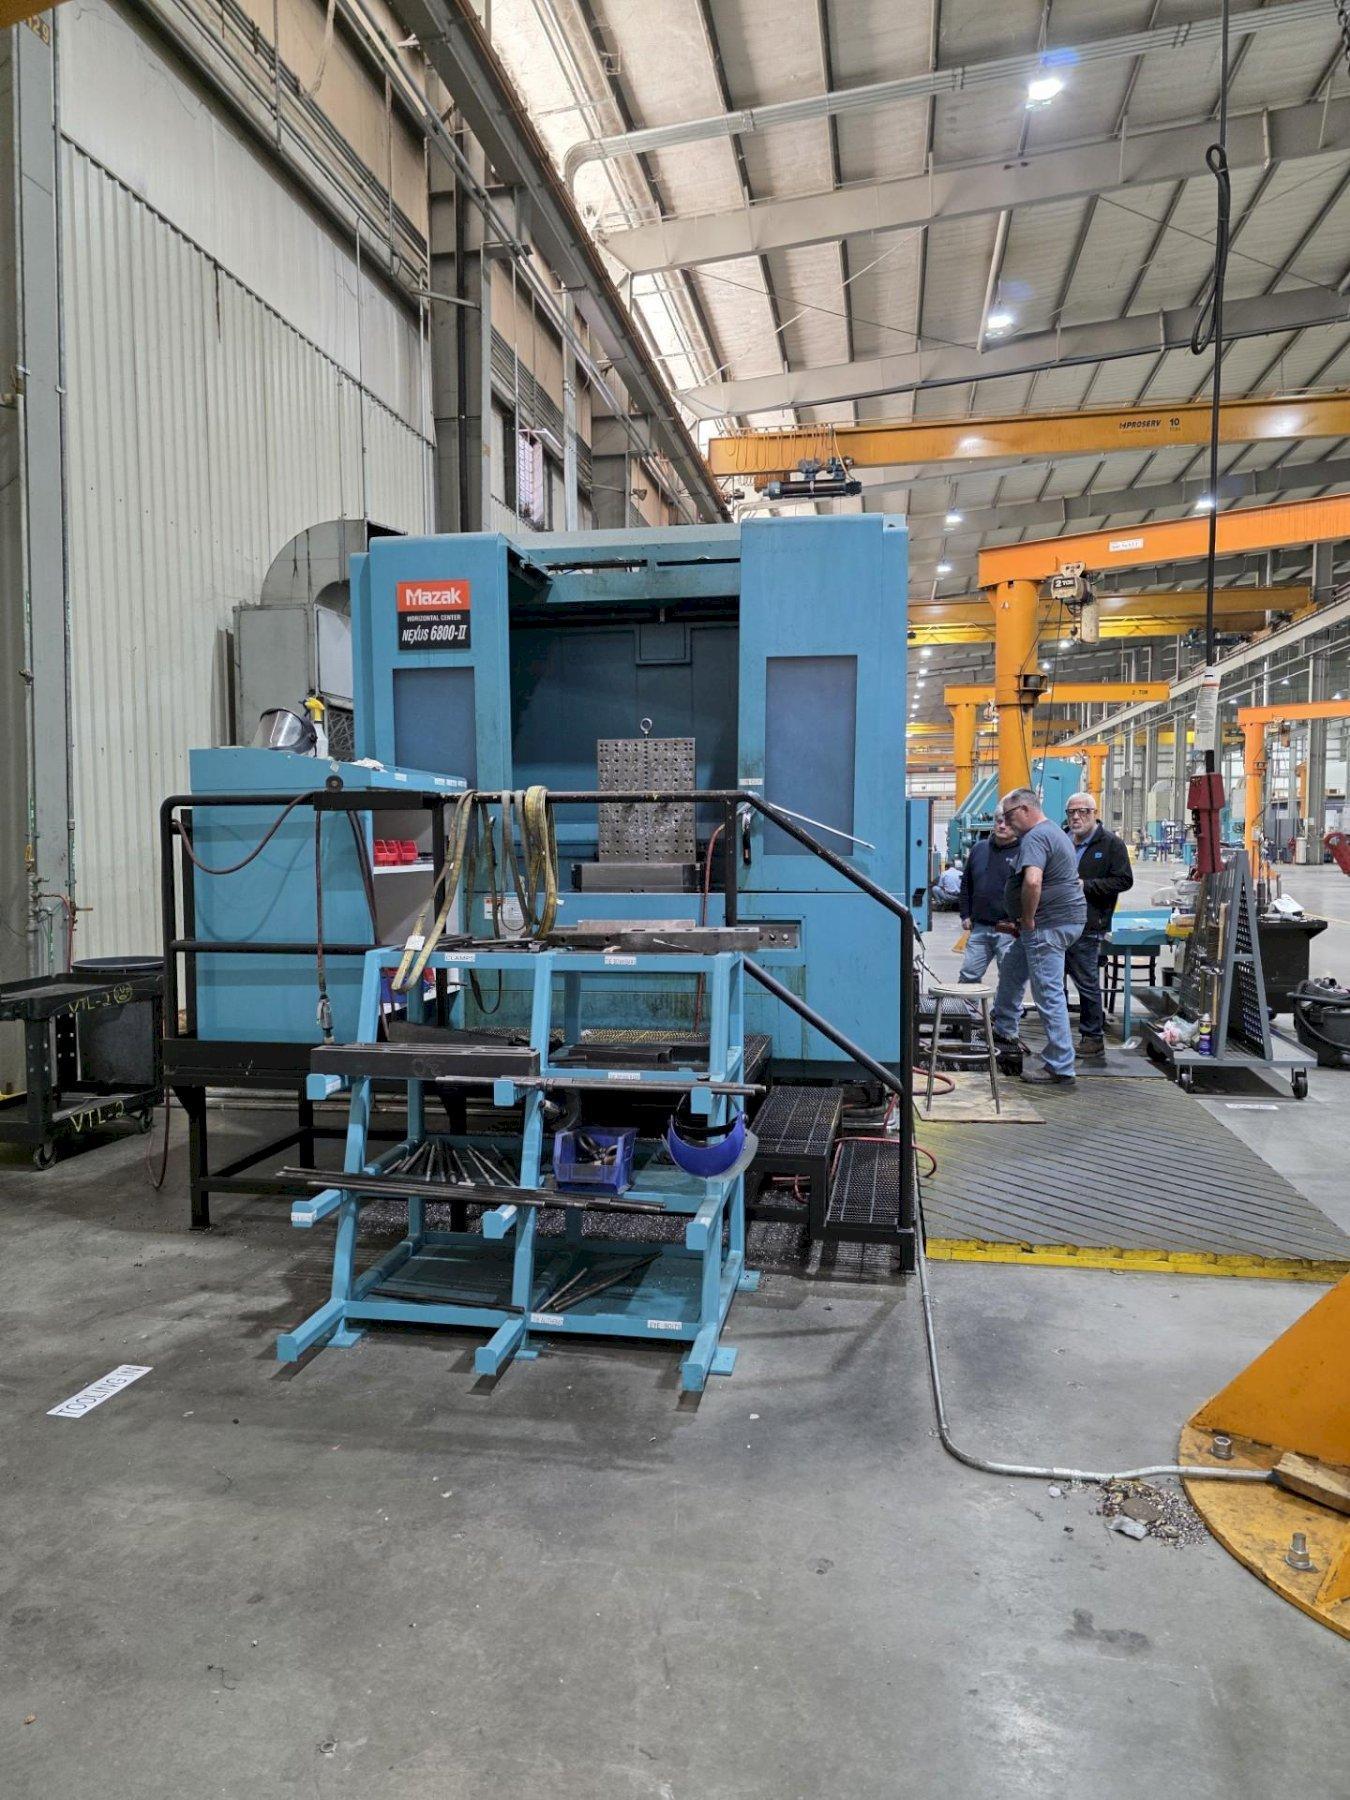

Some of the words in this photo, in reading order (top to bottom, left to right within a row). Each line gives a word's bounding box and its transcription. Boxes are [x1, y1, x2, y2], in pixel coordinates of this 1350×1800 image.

[1169, 418, 1180, 426] 10
[405, 587, 462, 606] Mazak
[401, 625, 429, 645] NEXUS
[430, 624, 467, 641] 6800-II
[70, 1100, 126, 1132] VTL-2
[56, 1378, 127, 1415] TOOLING
